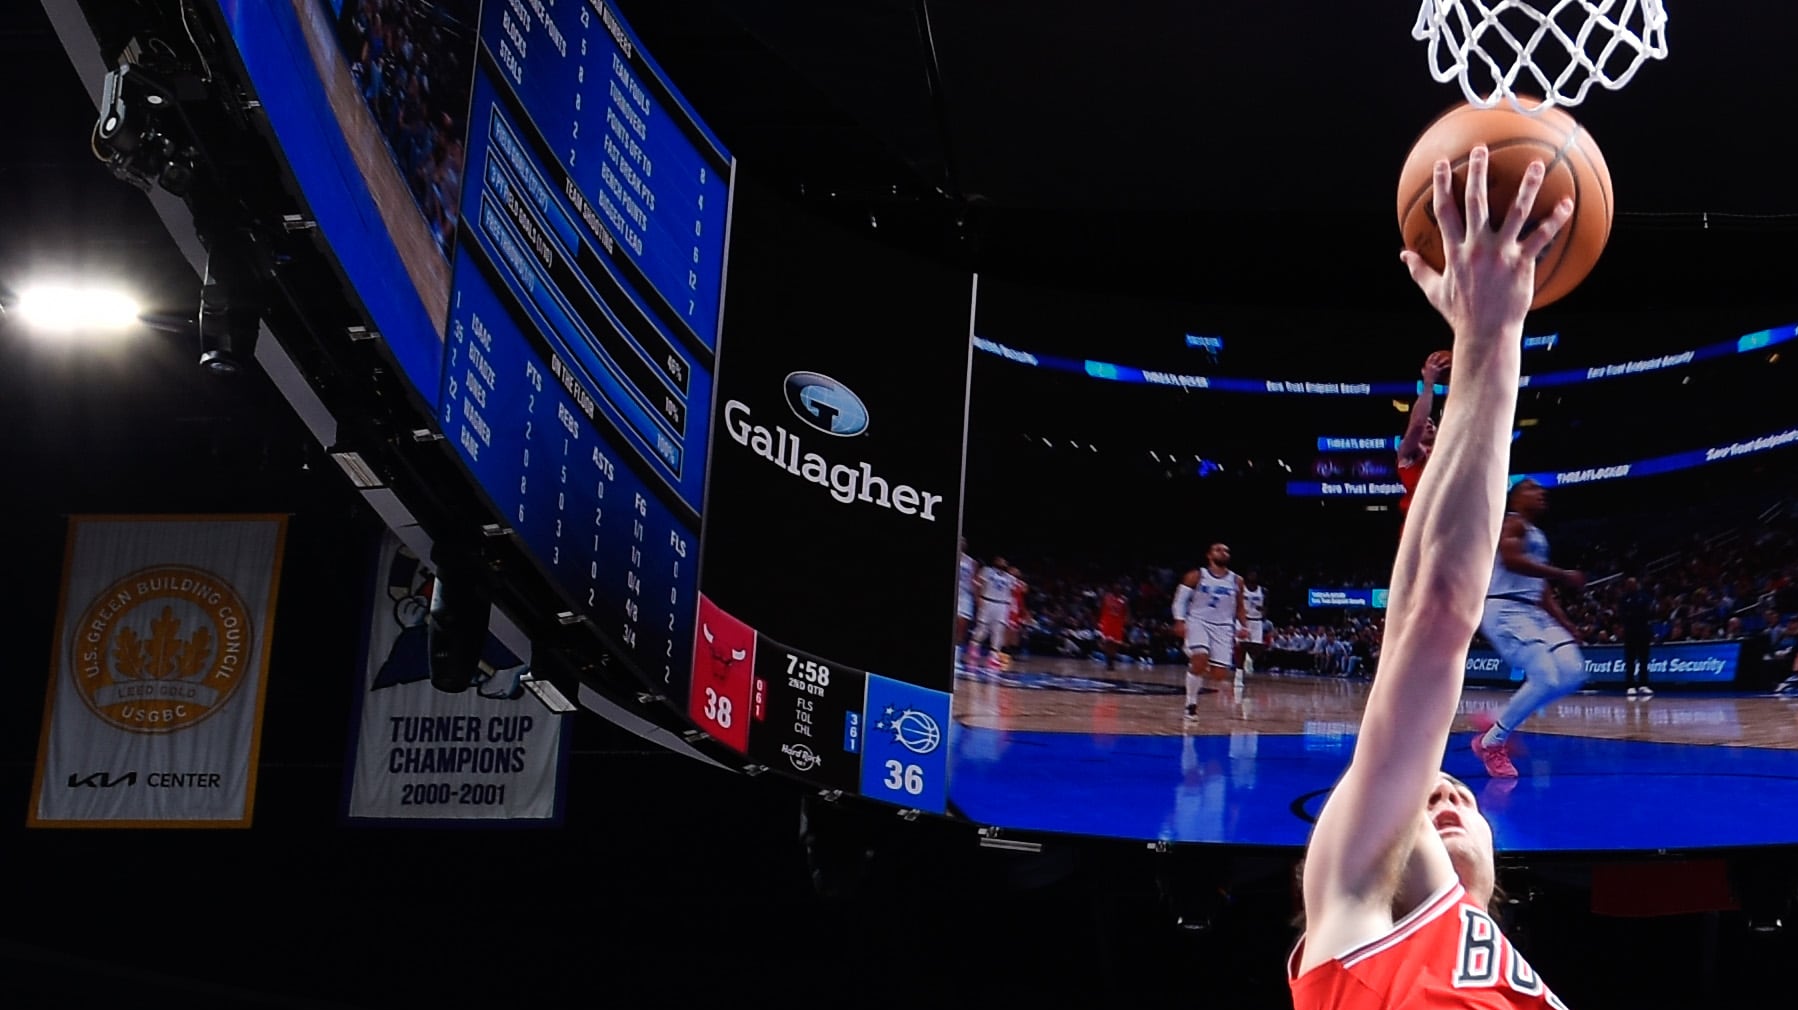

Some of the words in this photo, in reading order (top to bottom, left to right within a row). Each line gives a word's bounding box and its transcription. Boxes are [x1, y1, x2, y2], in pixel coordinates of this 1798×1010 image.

[503, 10, 526, 58] BLOCKS
[500, 40, 522, 85] STEALS
[612, 52, 629, 89] TEAM
[629, 76, 650, 116] FOULS
[610, 80, 646, 141] TURNOVERS
[565, 176, 583, 213] TEAM
[582, 207, 613, 255] SHOOTING
[472, 312, 491, 352] ISAAC
[466, 369, 486, 409] JONES
[552, 353, 562, 376] ON
[562, 368, 575, 393] THE
[574, 385, 594, 419] FLOOR
[464, 396, 491, 448] WAGNER
[461, 424, 479, 462] BANE
[526, 360, 542, 392] PTS
[558, 402, 579, 439] REBS
[592, 446, 614, 481] ASTS
[634, 492, 647, 517] FG
[670, 530, 687, 558] FLS
[725, 399, 942, 522] Gallagher
[87, 590, 133, 643] GREEN
[136, 577, 222, 606] BUILDING
[215, 607, 241, 680] COUNCIL
[786, 653, 830, 687] 7:58
[1584, 660, 1612, 672] Trust
[1669, 656, 1726, 675] Security
[118, 684, 153, 698] LEED
[159, 684, 196, 698] GOLD
[757, 679, 763, 691] 0
[788, 677, 805, 691] 2ND
[807, 682, 825, 698] QTR
[121, 704, 187, 723] USGBC
[704, 687, 732, 728] 38
[795, 710, 813, 724] TOL
[797, 698, 813, 711] FLS
[850, 714, 858, 725] 3
[390, 716, 481, 743] TURNER
[487, 716, 533, 743] CUP
[794, 723, 812, 737] CHL
[389, 747, 526, 773] CHAMPIONS
[781, 743, 803, 759] Hard
[802, 750, 822, 766] Rock
[147, 773, 221, 788] CENTER
[401, 783, 506, 805] 2000-2001
[883, 759, 924, 795] 36
